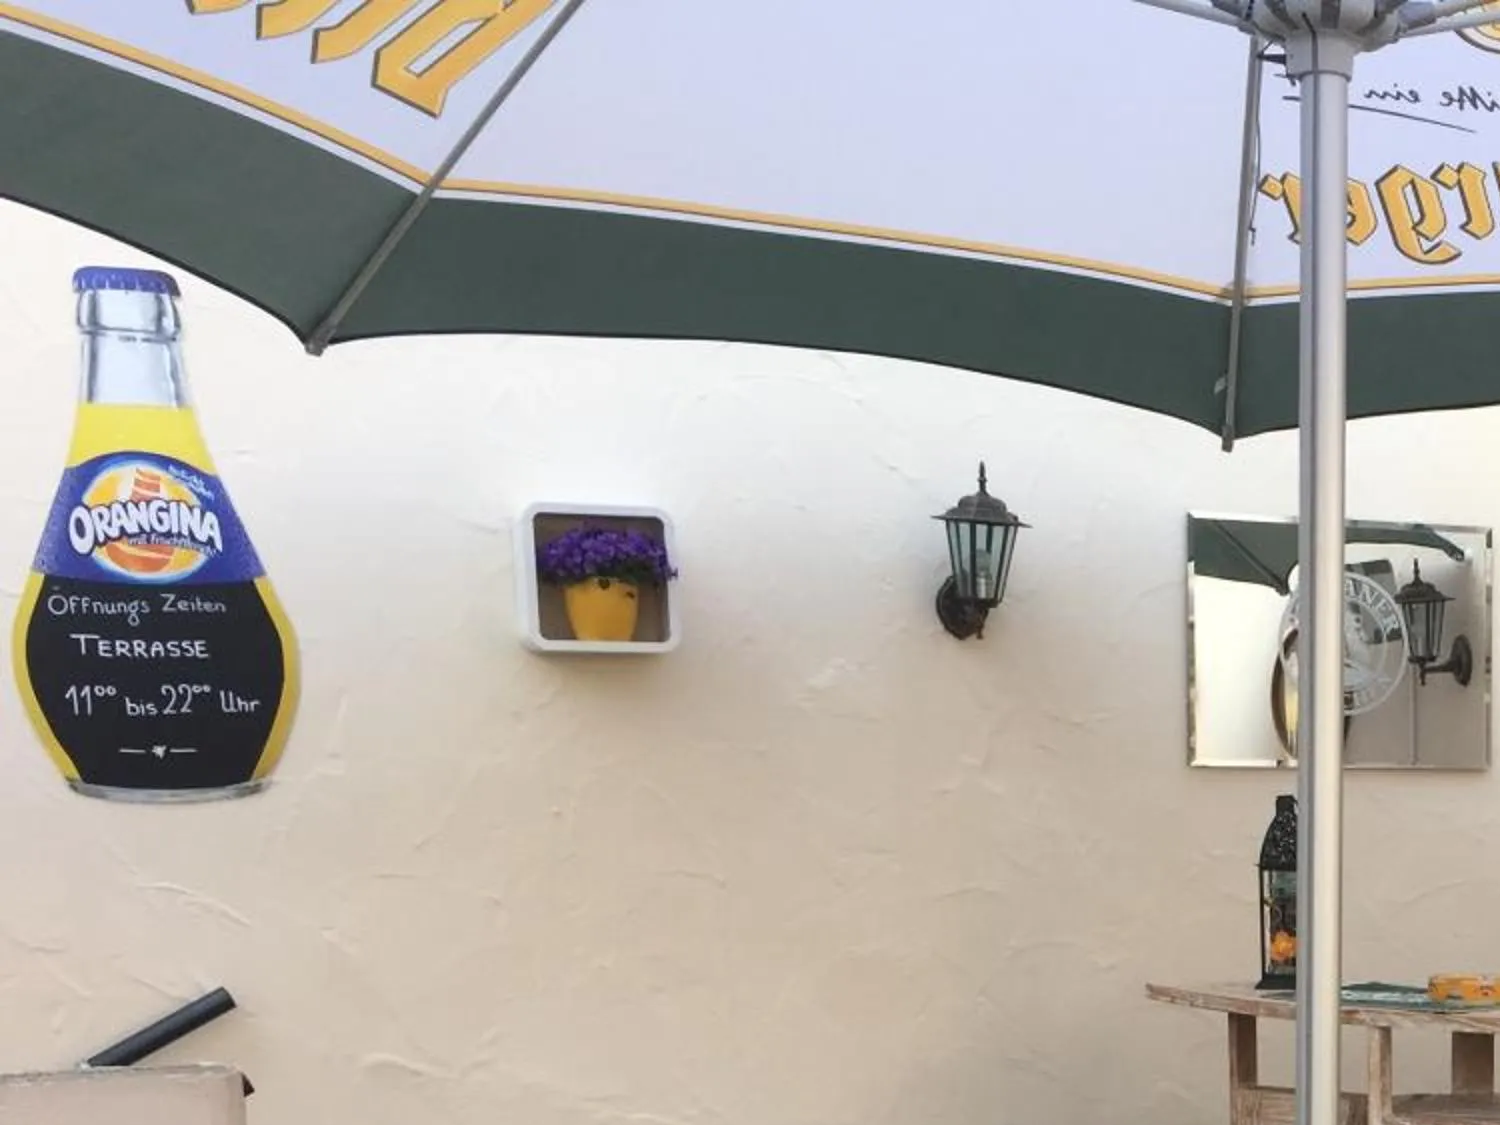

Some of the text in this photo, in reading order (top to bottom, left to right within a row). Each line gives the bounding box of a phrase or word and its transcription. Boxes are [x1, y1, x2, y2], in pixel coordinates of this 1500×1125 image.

[69, 499, 223, 555] ORANGINA
[160, 592, 227, 614] Zeiten
[69, 633, 210, 659] TERRASSE
[125, 696, 158, 717] bis
[219, 690, 262, 713] Uhr
